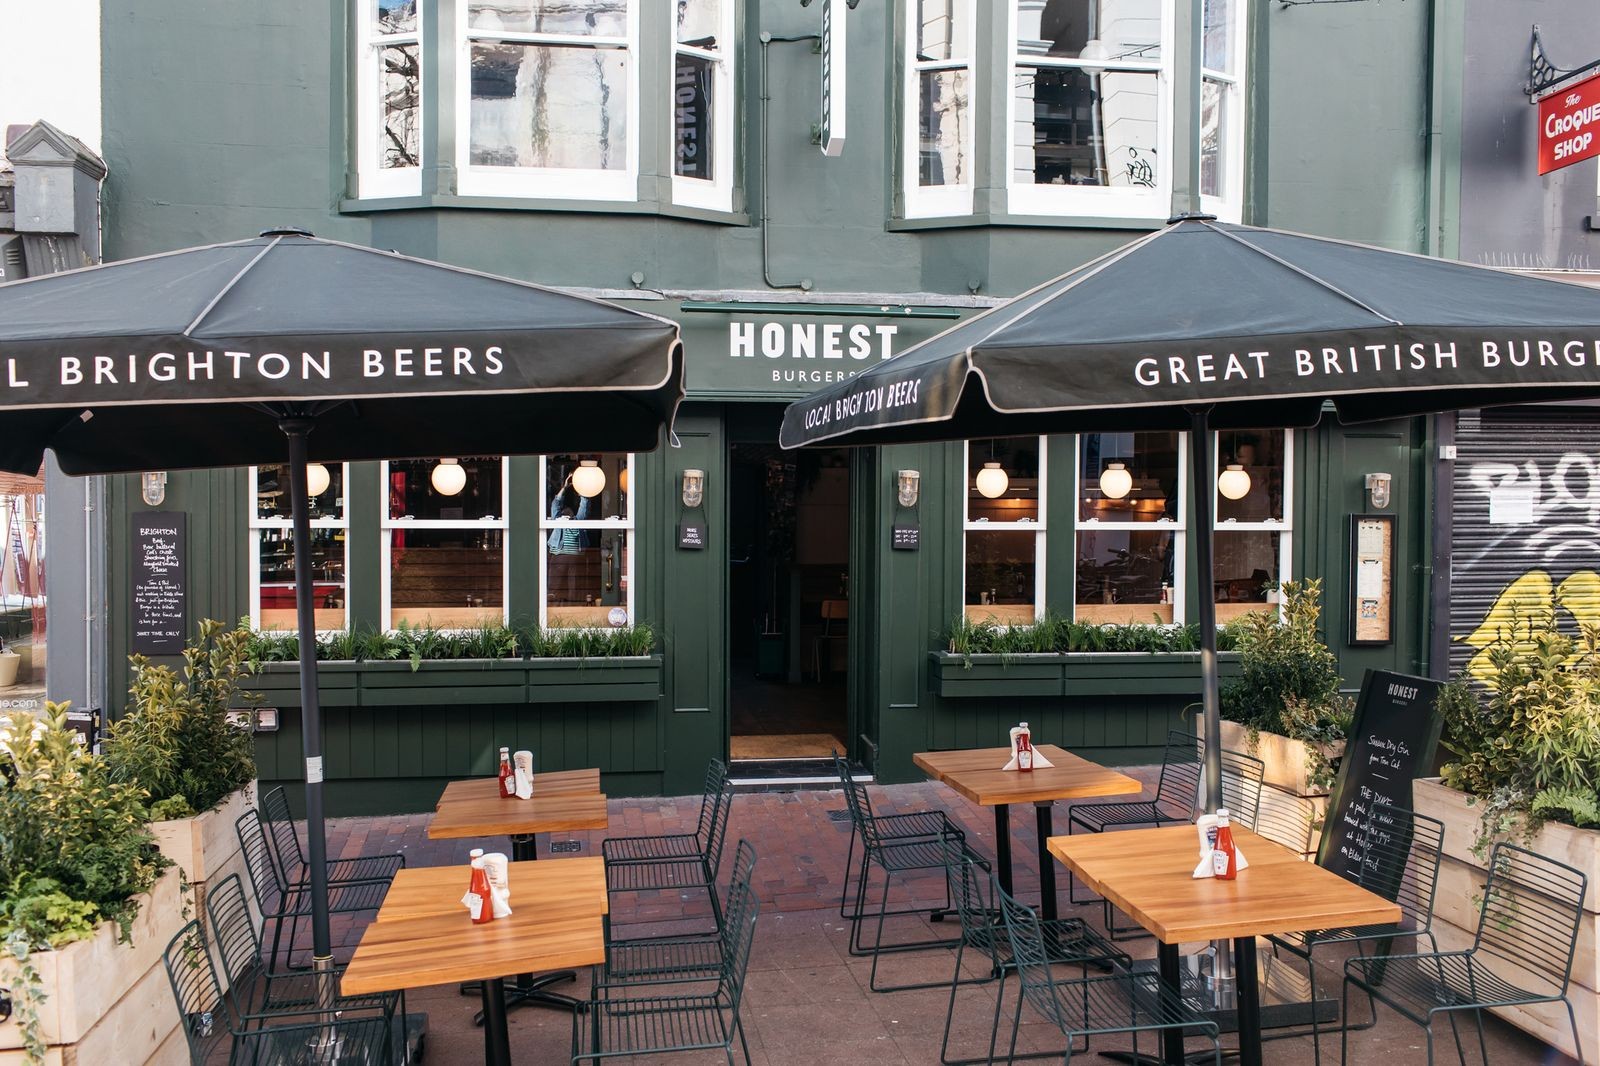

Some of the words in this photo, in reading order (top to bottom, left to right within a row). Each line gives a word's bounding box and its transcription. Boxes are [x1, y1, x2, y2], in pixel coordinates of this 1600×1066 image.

[1564, 93, 1582, 108] The
[1545, 102, 1600, 138] CROQUE
[1554, 132, 1593, 161] SHOP
[729, 321, 898, 360] HONEST
[60, 351, 331, 385] BRIGHTON
[363, 346, 504, 378] BEERS
[1134, 351, 1270, 387] GREAT
[1295, 342, 1458, 376] BRITISH
[805, 403, 832, 430] LOCAL
[886, 378, 921, 408] BEERS
[140, 527, 177, 536] BRIGHTON
[1387, 683, 1419, 700] HONEST
[0, 700, 38, 709] e.com
[1397, 741, 1411, 757] Gin
[1360, 785, 1373, 799] THE
